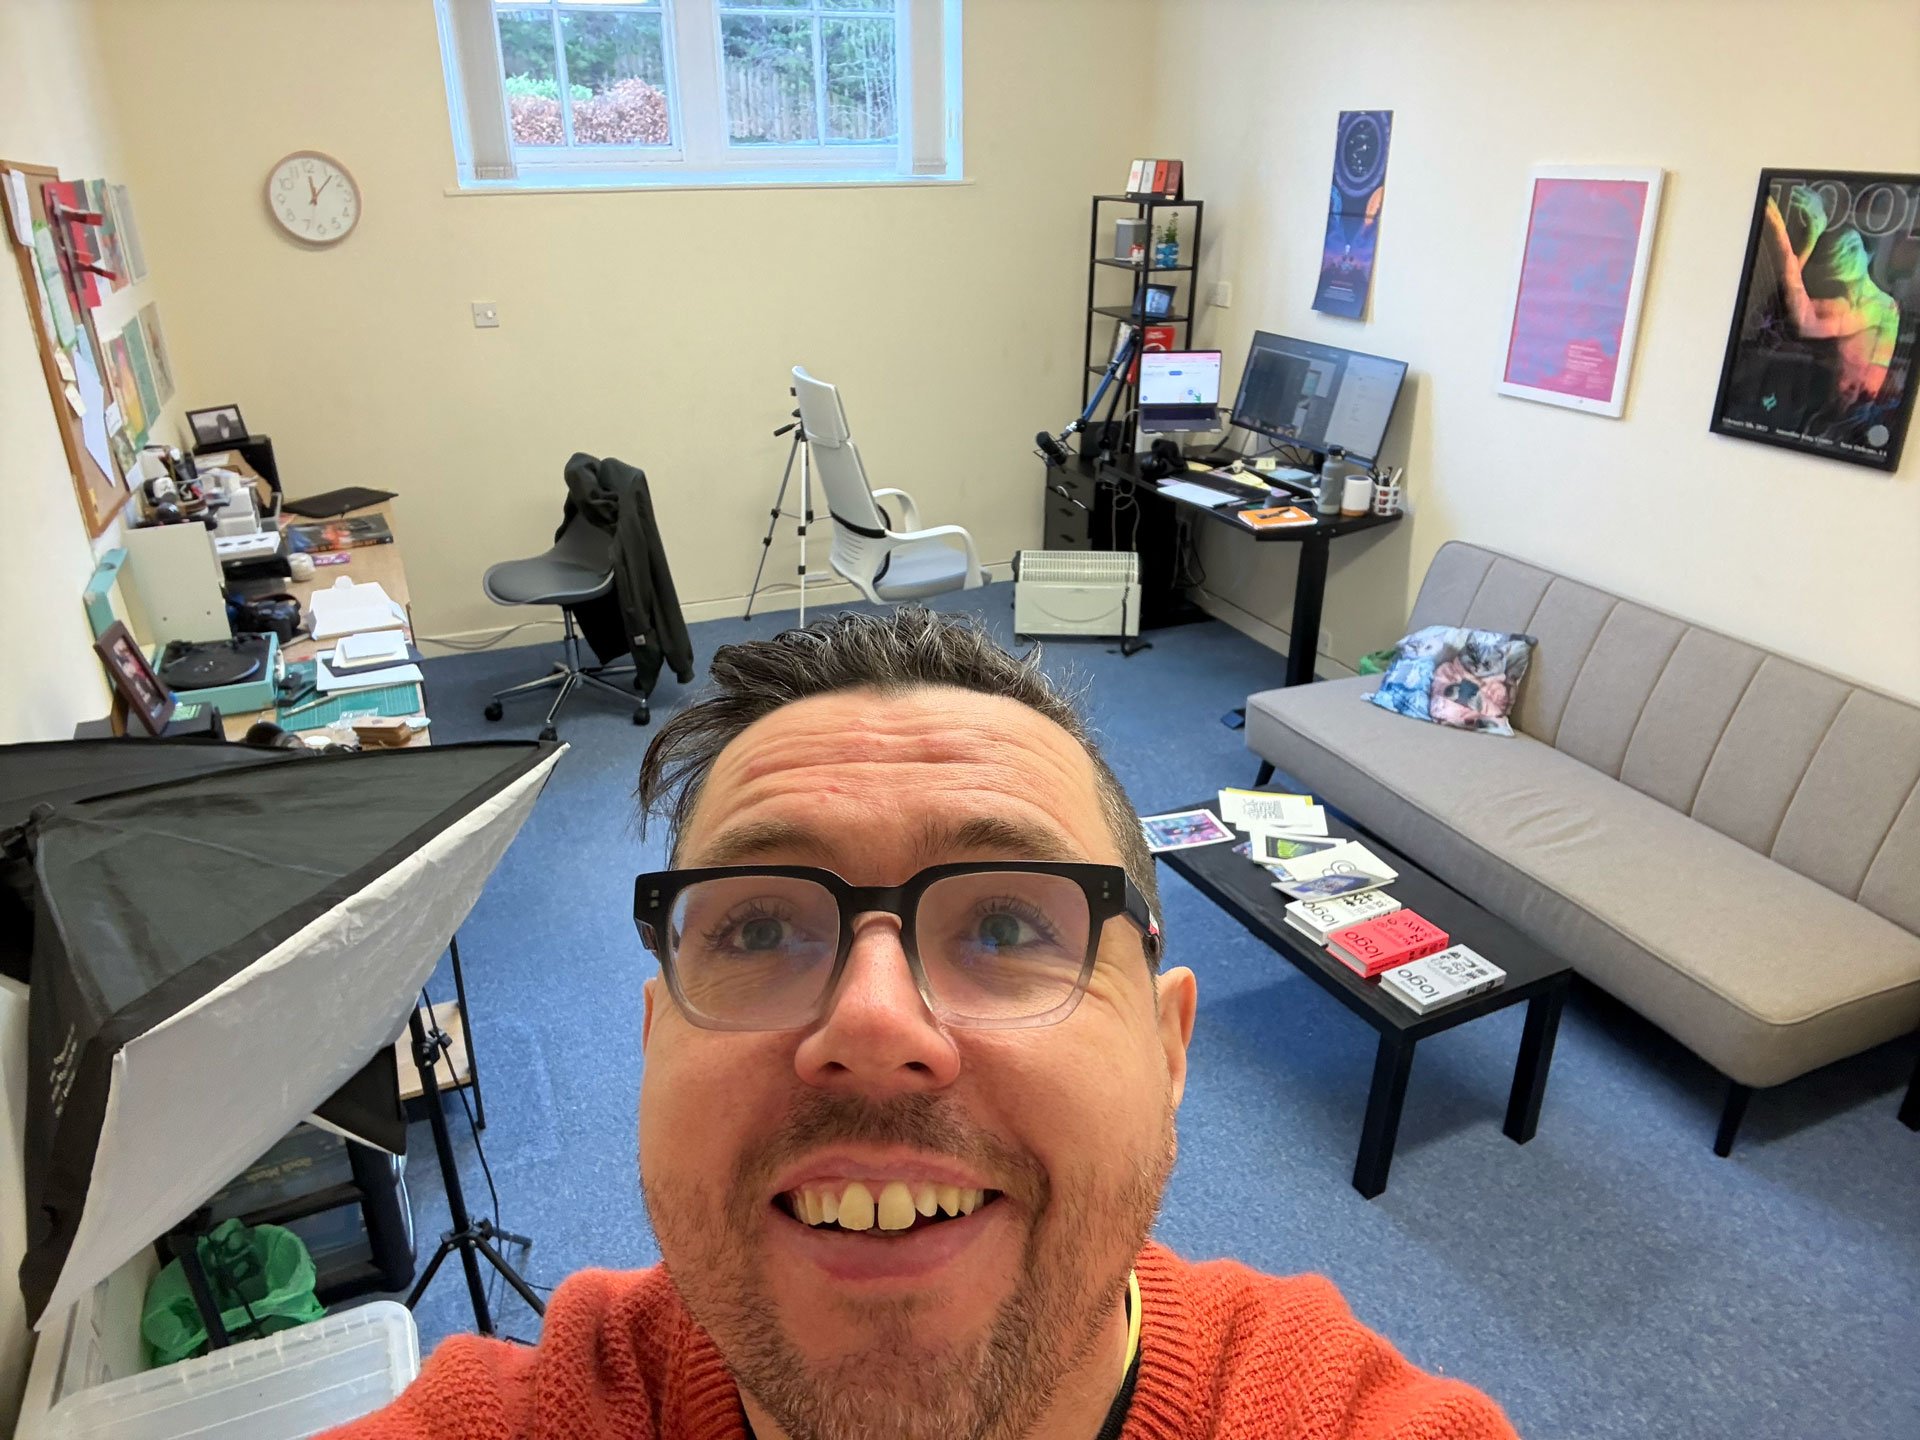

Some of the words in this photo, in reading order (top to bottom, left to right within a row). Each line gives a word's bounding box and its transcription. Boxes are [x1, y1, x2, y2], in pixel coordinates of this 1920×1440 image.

[1302, 901, 1340, 927] logo
[1344, 930, 1384, 959] logo
[1397, 968, 1440, 999] logo
